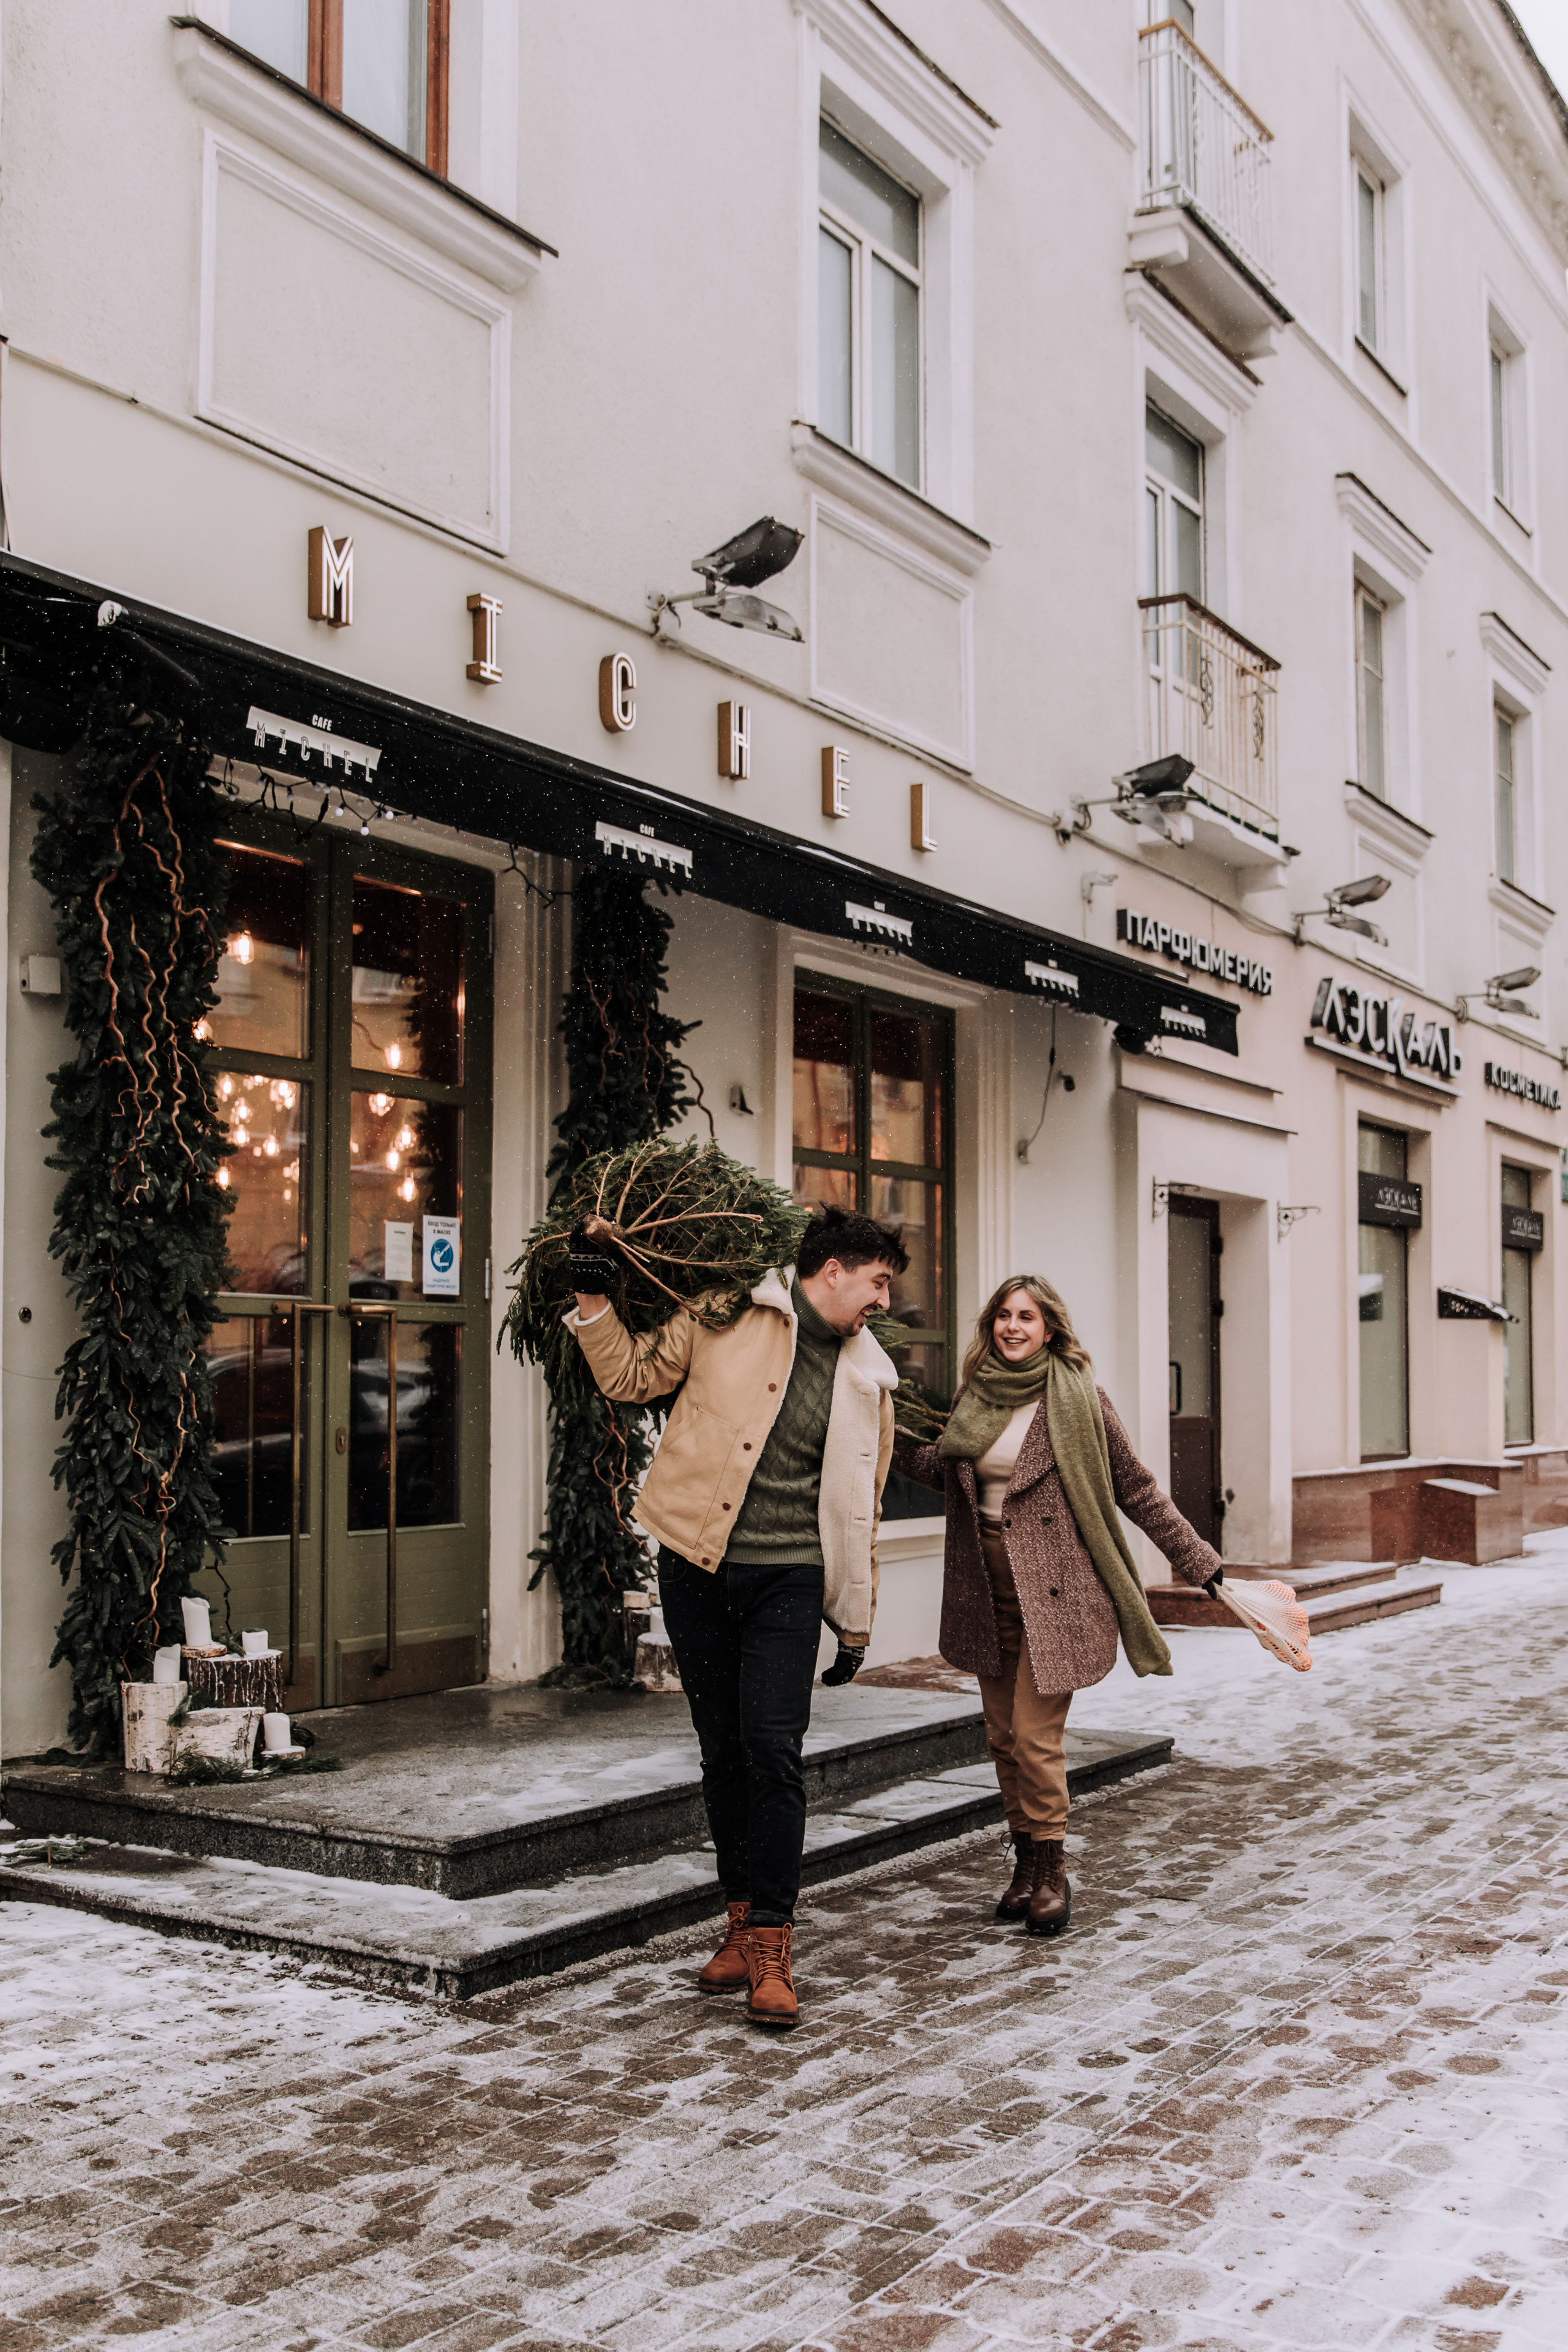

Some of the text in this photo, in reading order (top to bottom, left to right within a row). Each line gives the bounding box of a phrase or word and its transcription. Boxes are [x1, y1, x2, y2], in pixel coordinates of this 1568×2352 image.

[308, 525, 938, 853] MICHEL
[312, 714, 333, 731] CAFE
[254, 720, 373, 783] MICHEL
[603, 834, 692, 879] MICHEL
[639, 823, 655, 837] CAFE
[1117, 907, 1275, 995] ПАРФЮМЕРИЯ
[1310, 978, 1463, 1078] ЛЭСКАЛЬ
[1485, 1062, 1562, 1109] КОСМЕТИКА
